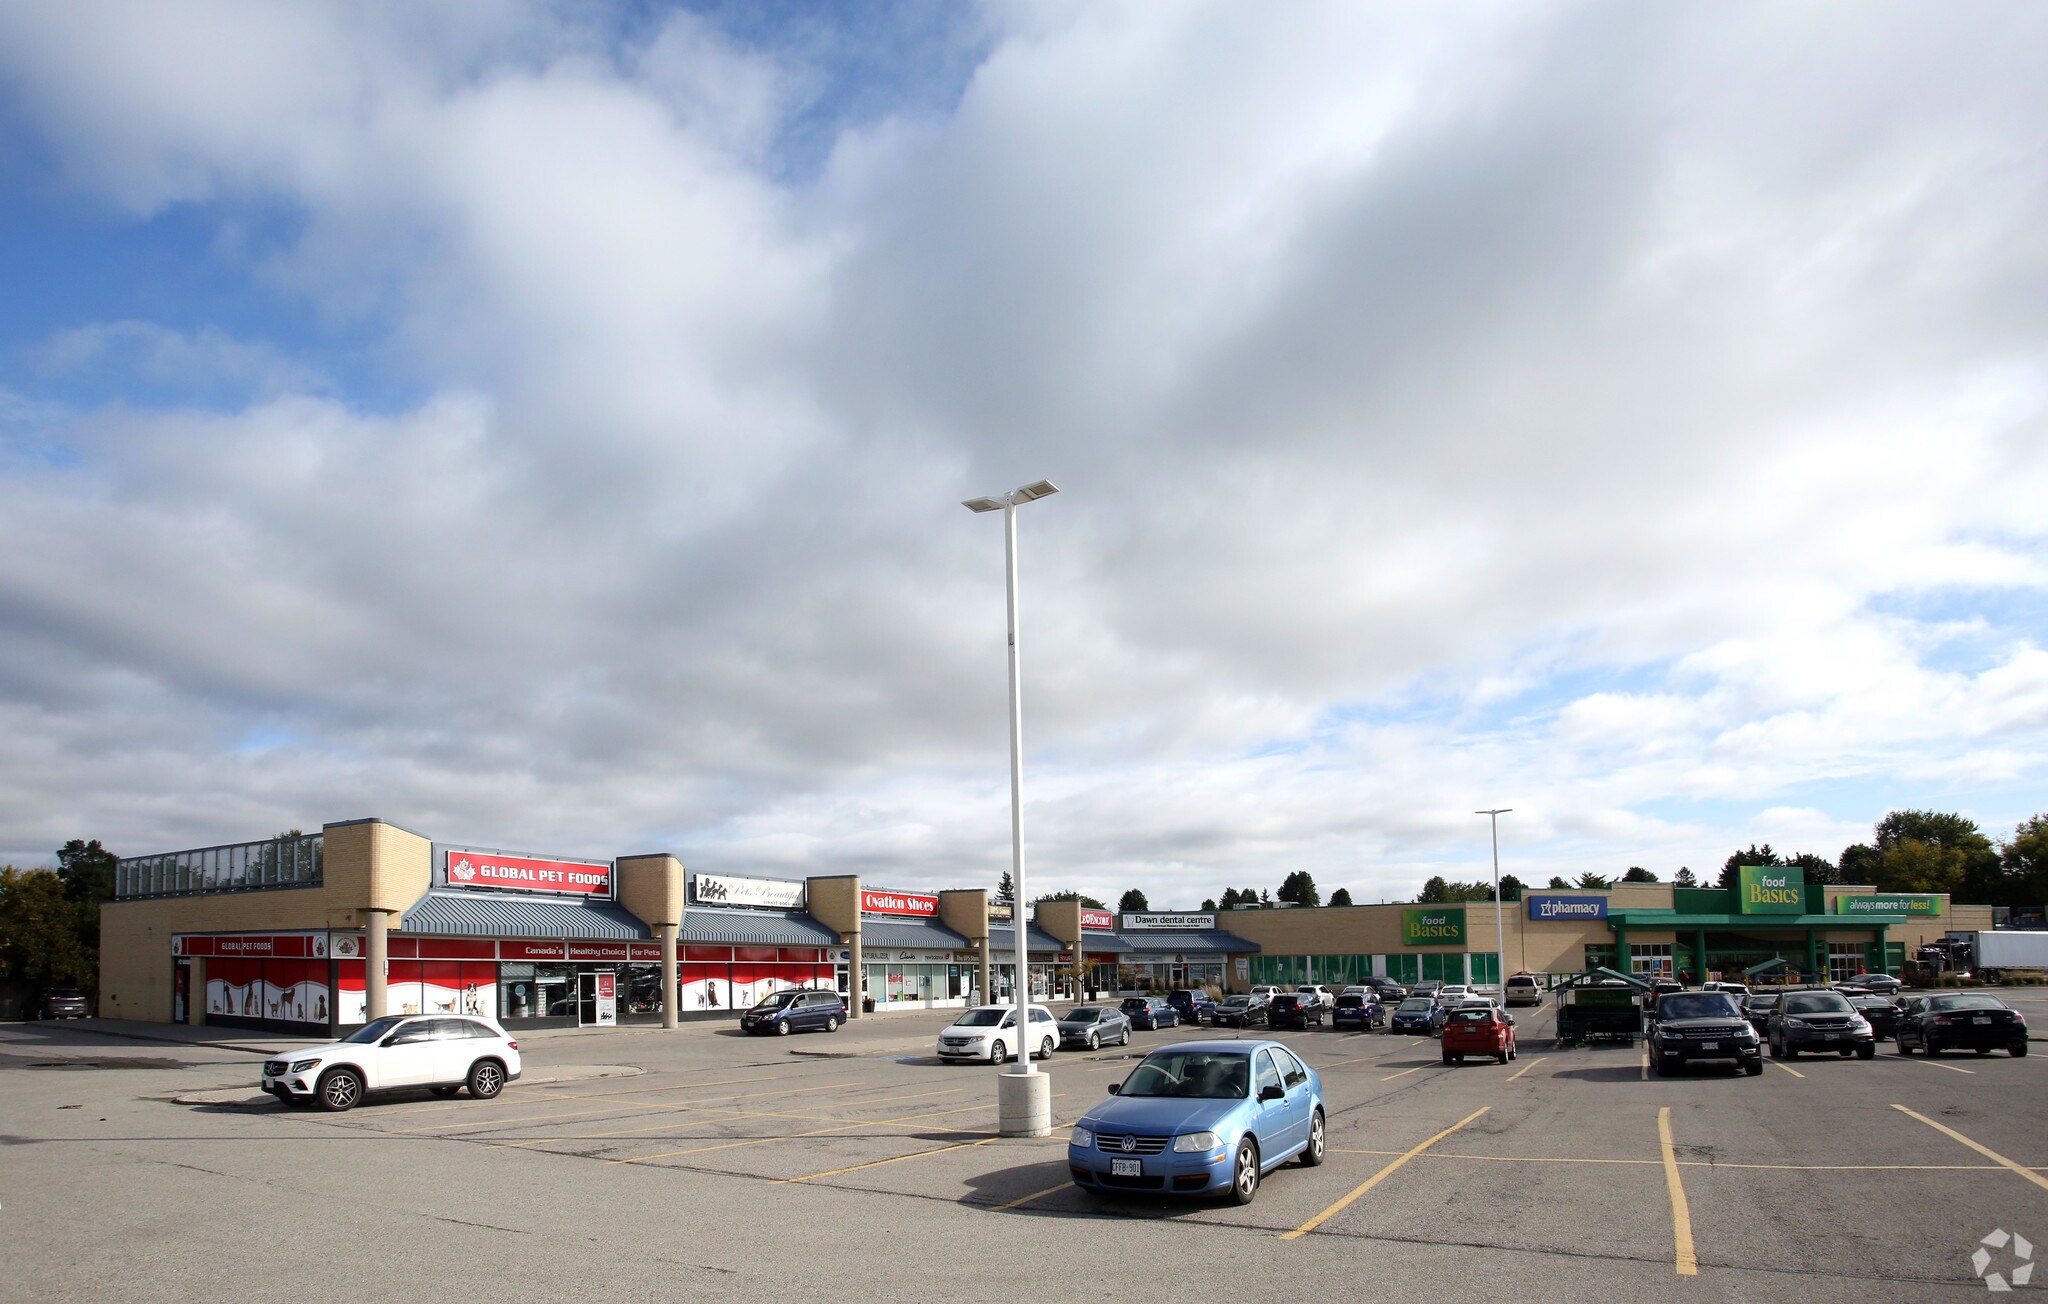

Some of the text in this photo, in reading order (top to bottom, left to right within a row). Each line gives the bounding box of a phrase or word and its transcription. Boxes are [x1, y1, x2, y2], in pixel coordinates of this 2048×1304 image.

[480, 864, 609, 886] GLOBAL PET FOODS
[1761, 875, 1786, 887] food
[866, 894, 934, 912] Ovation Shoes
[1850, 899, 1930, 912] always more for less!
[1552, 903, 1600, 916] pharmacy
[1135, 916, 1211, 924] Dawn dental centre
[1422, 916, 1446, 925] food
[221, 942, 272, 950] GLOBAL PET FOODS
[525, 947, 563, 955] Canada's
[570, 948, 600, 957] Healthy
[601, 948, 626, 956] Choice
